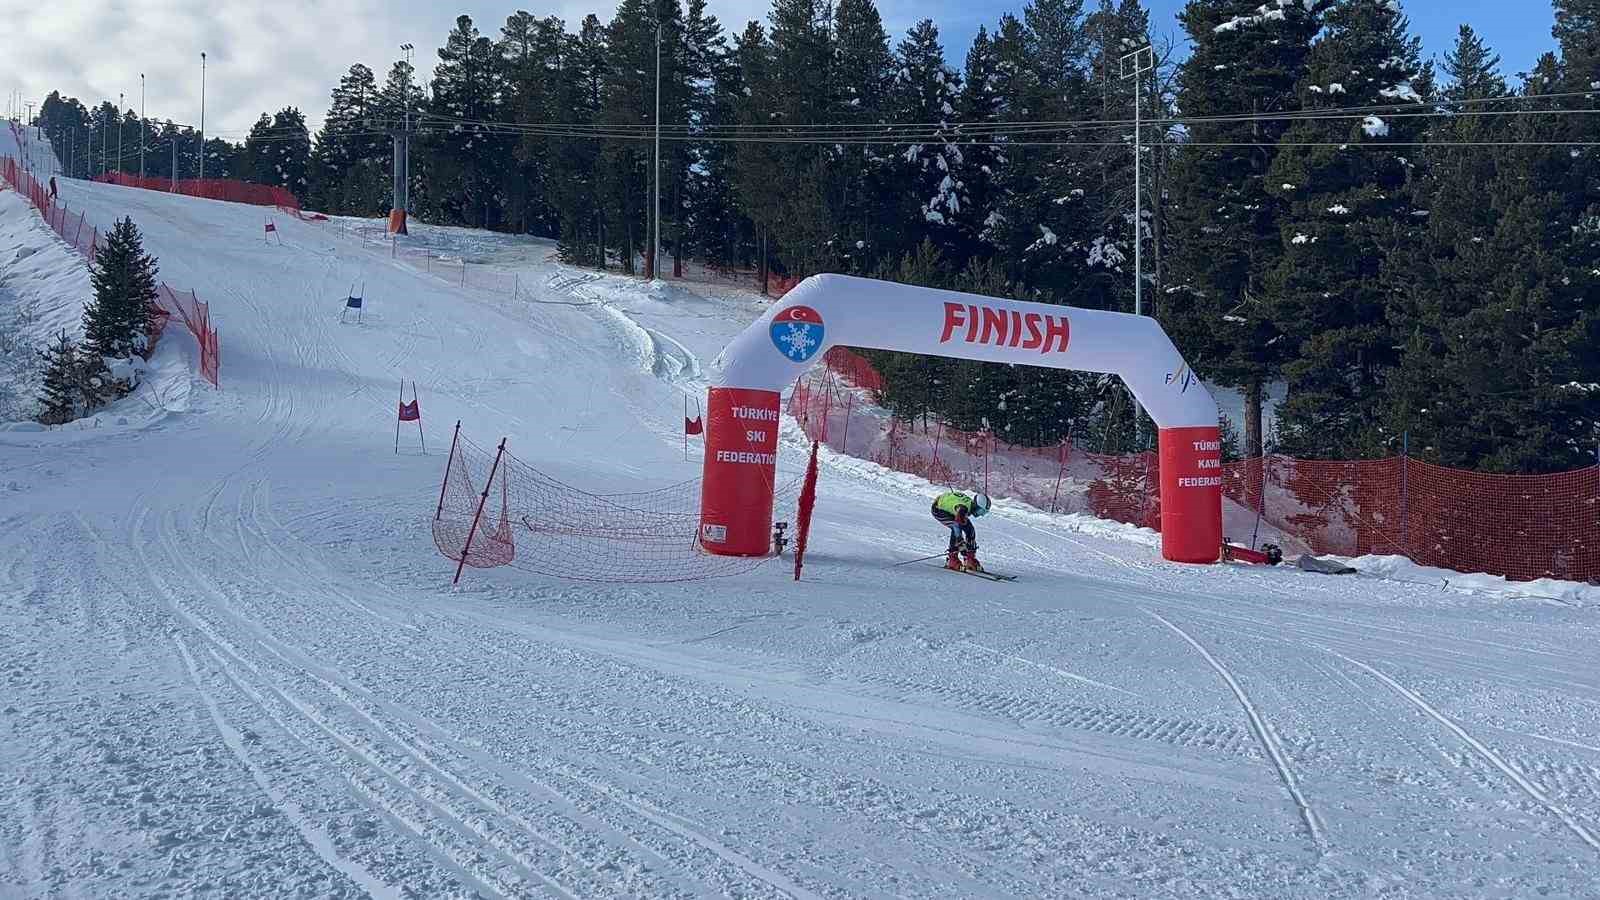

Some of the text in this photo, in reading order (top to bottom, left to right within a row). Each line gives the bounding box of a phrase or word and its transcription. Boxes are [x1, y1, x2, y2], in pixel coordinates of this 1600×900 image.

[940, 301, 1070, 354] FINISH
[731, 405, 778, 421] TÜRKİYE
[746, 430, 766, 442] SKI
